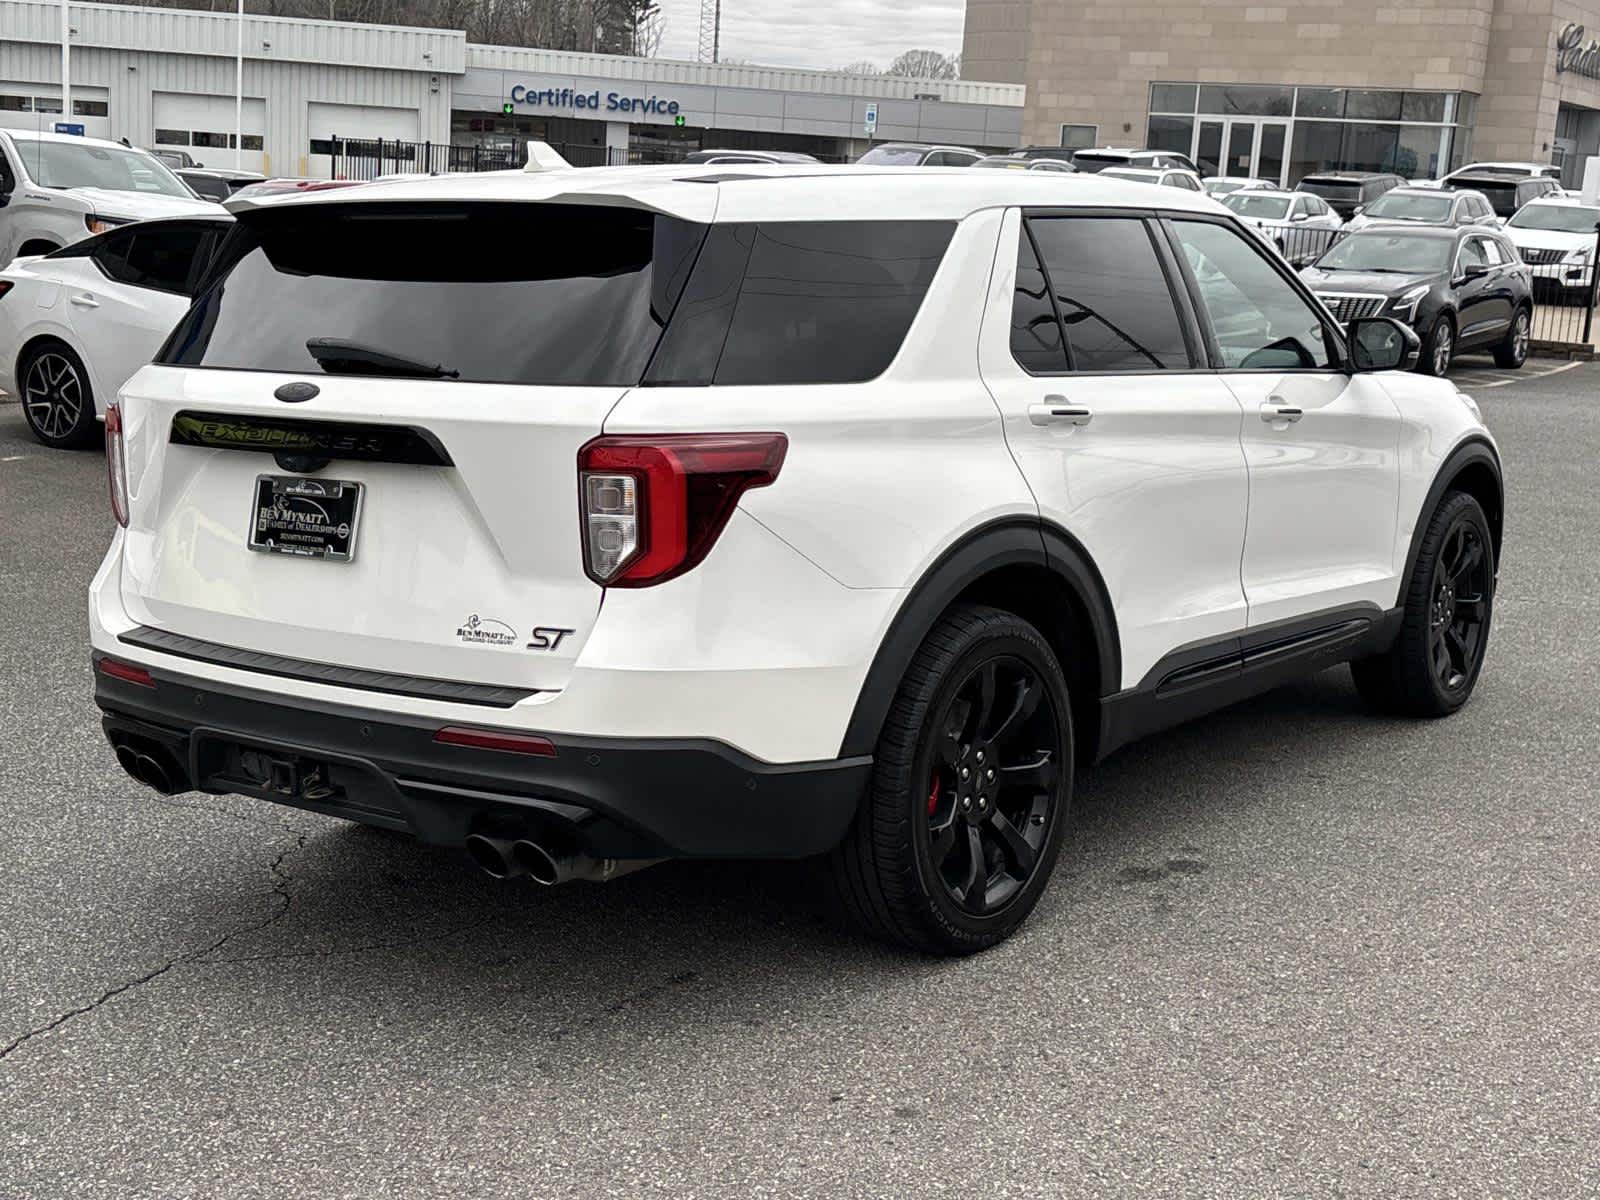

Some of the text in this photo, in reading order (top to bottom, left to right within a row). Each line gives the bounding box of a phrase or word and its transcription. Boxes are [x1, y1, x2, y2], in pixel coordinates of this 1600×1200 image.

[511, 85, 680, 116] Certified Service
[260, 507, 324, 524] BEN MYNATT
[456, 628, 472, 636] BEN
[527, 627, 576, 650] ST
